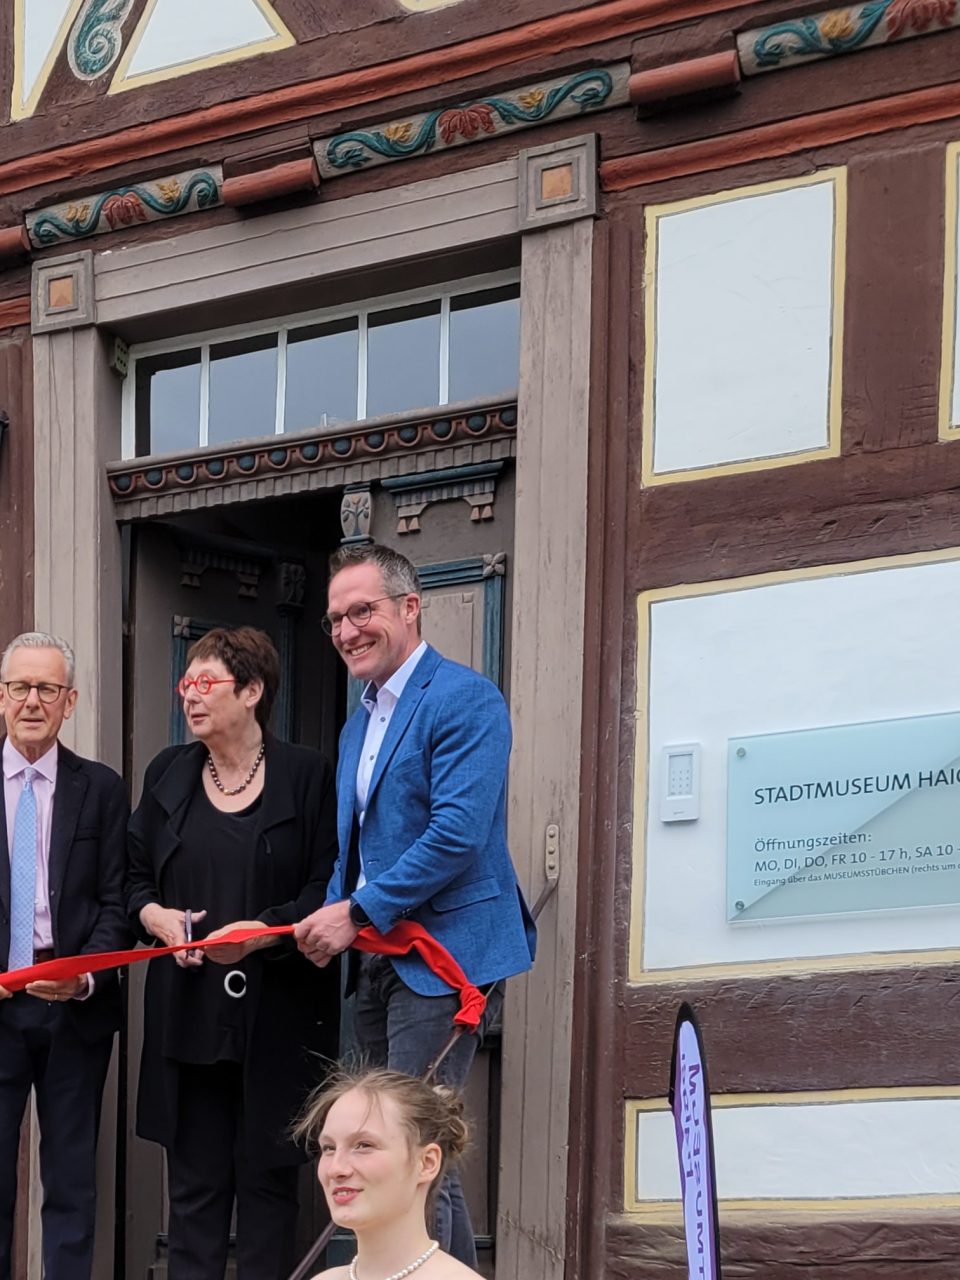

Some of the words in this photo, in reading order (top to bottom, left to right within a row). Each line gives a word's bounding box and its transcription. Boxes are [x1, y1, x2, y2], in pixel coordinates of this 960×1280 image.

[754, 773, 911, 805] STADTMUSEUM
[918, 767, 960, 788] HAI
[754, 832, 872, 852] Öffnungszeiten:
[754, 860, 780, 872] MO,
[784, 858, 801, 870] DI,
[804, 855, 828, 868] DO,
[831, 853, 847, 865] FR
[851, 852, 867, 864] 10
[879, 849, 896, 861] 17
[899, 847, 912, 860] h,
[915, 846, 933, 858] SA
[936, 844, 954, 857] 10
[754, 876, 786, 887] Eingang
[787, 875, 806, 884] über
[807, 874, 822, 882] das
[823, 866, 910, 880] MUSEUMSSTÜBCHEN
[911, 863, 940, 874] (rechts
[941, 863, 956, 871] um
